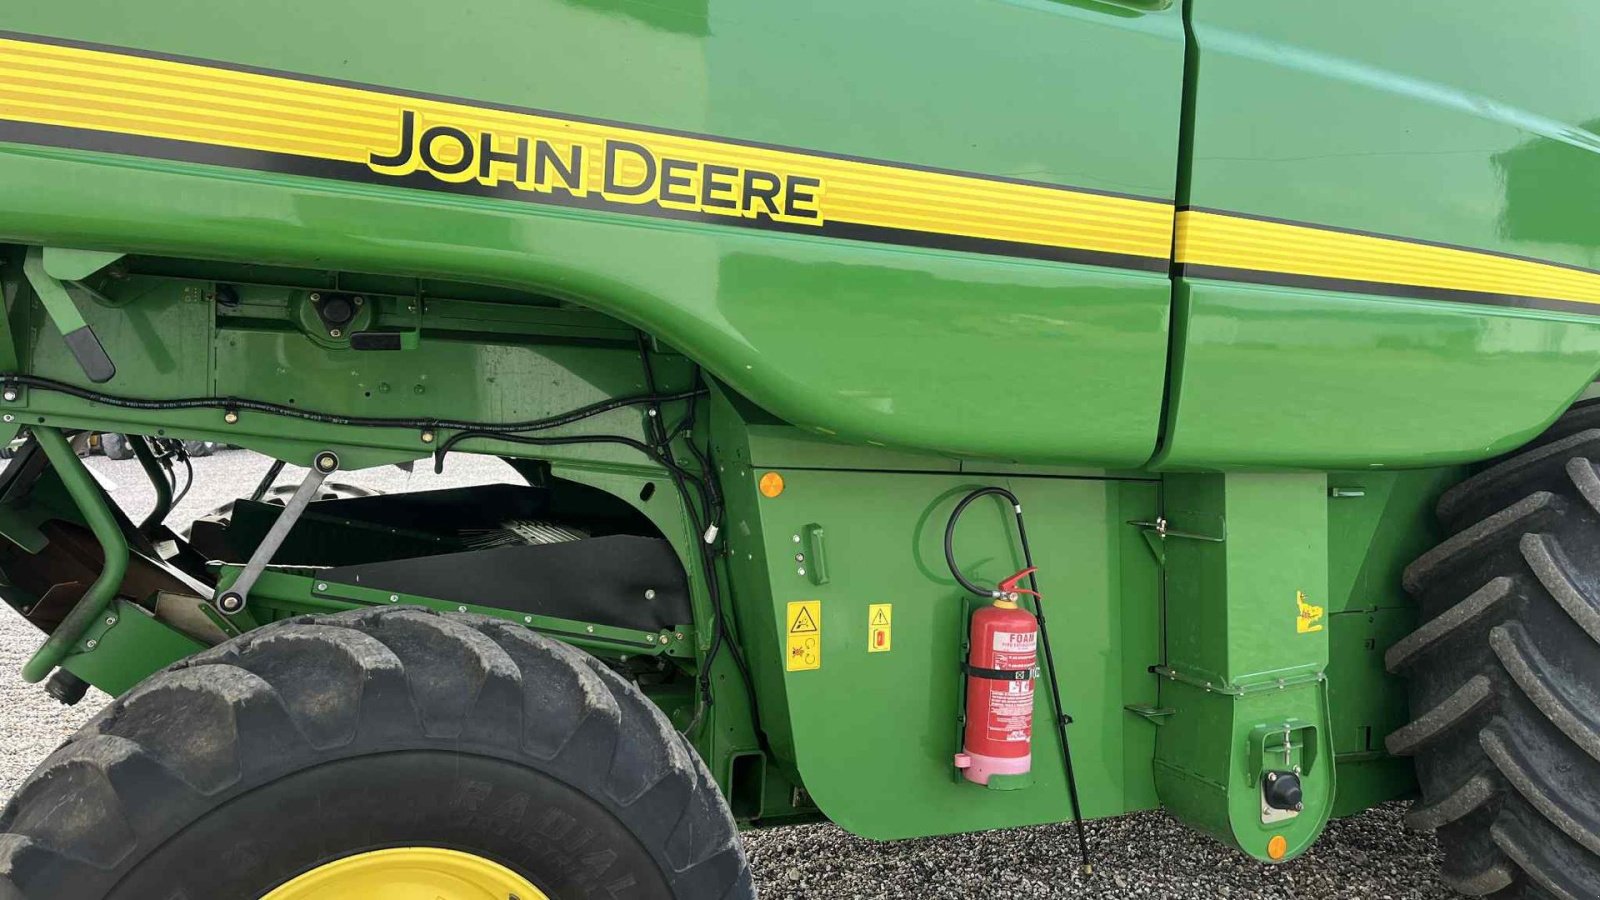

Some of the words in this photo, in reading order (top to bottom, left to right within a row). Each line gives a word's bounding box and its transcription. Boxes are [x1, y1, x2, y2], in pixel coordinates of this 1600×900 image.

[368, 109, 583, 191] JOHN
[603, 139, 822, 220] DEERE
[1009, 633, 1035, 643] FOAM
